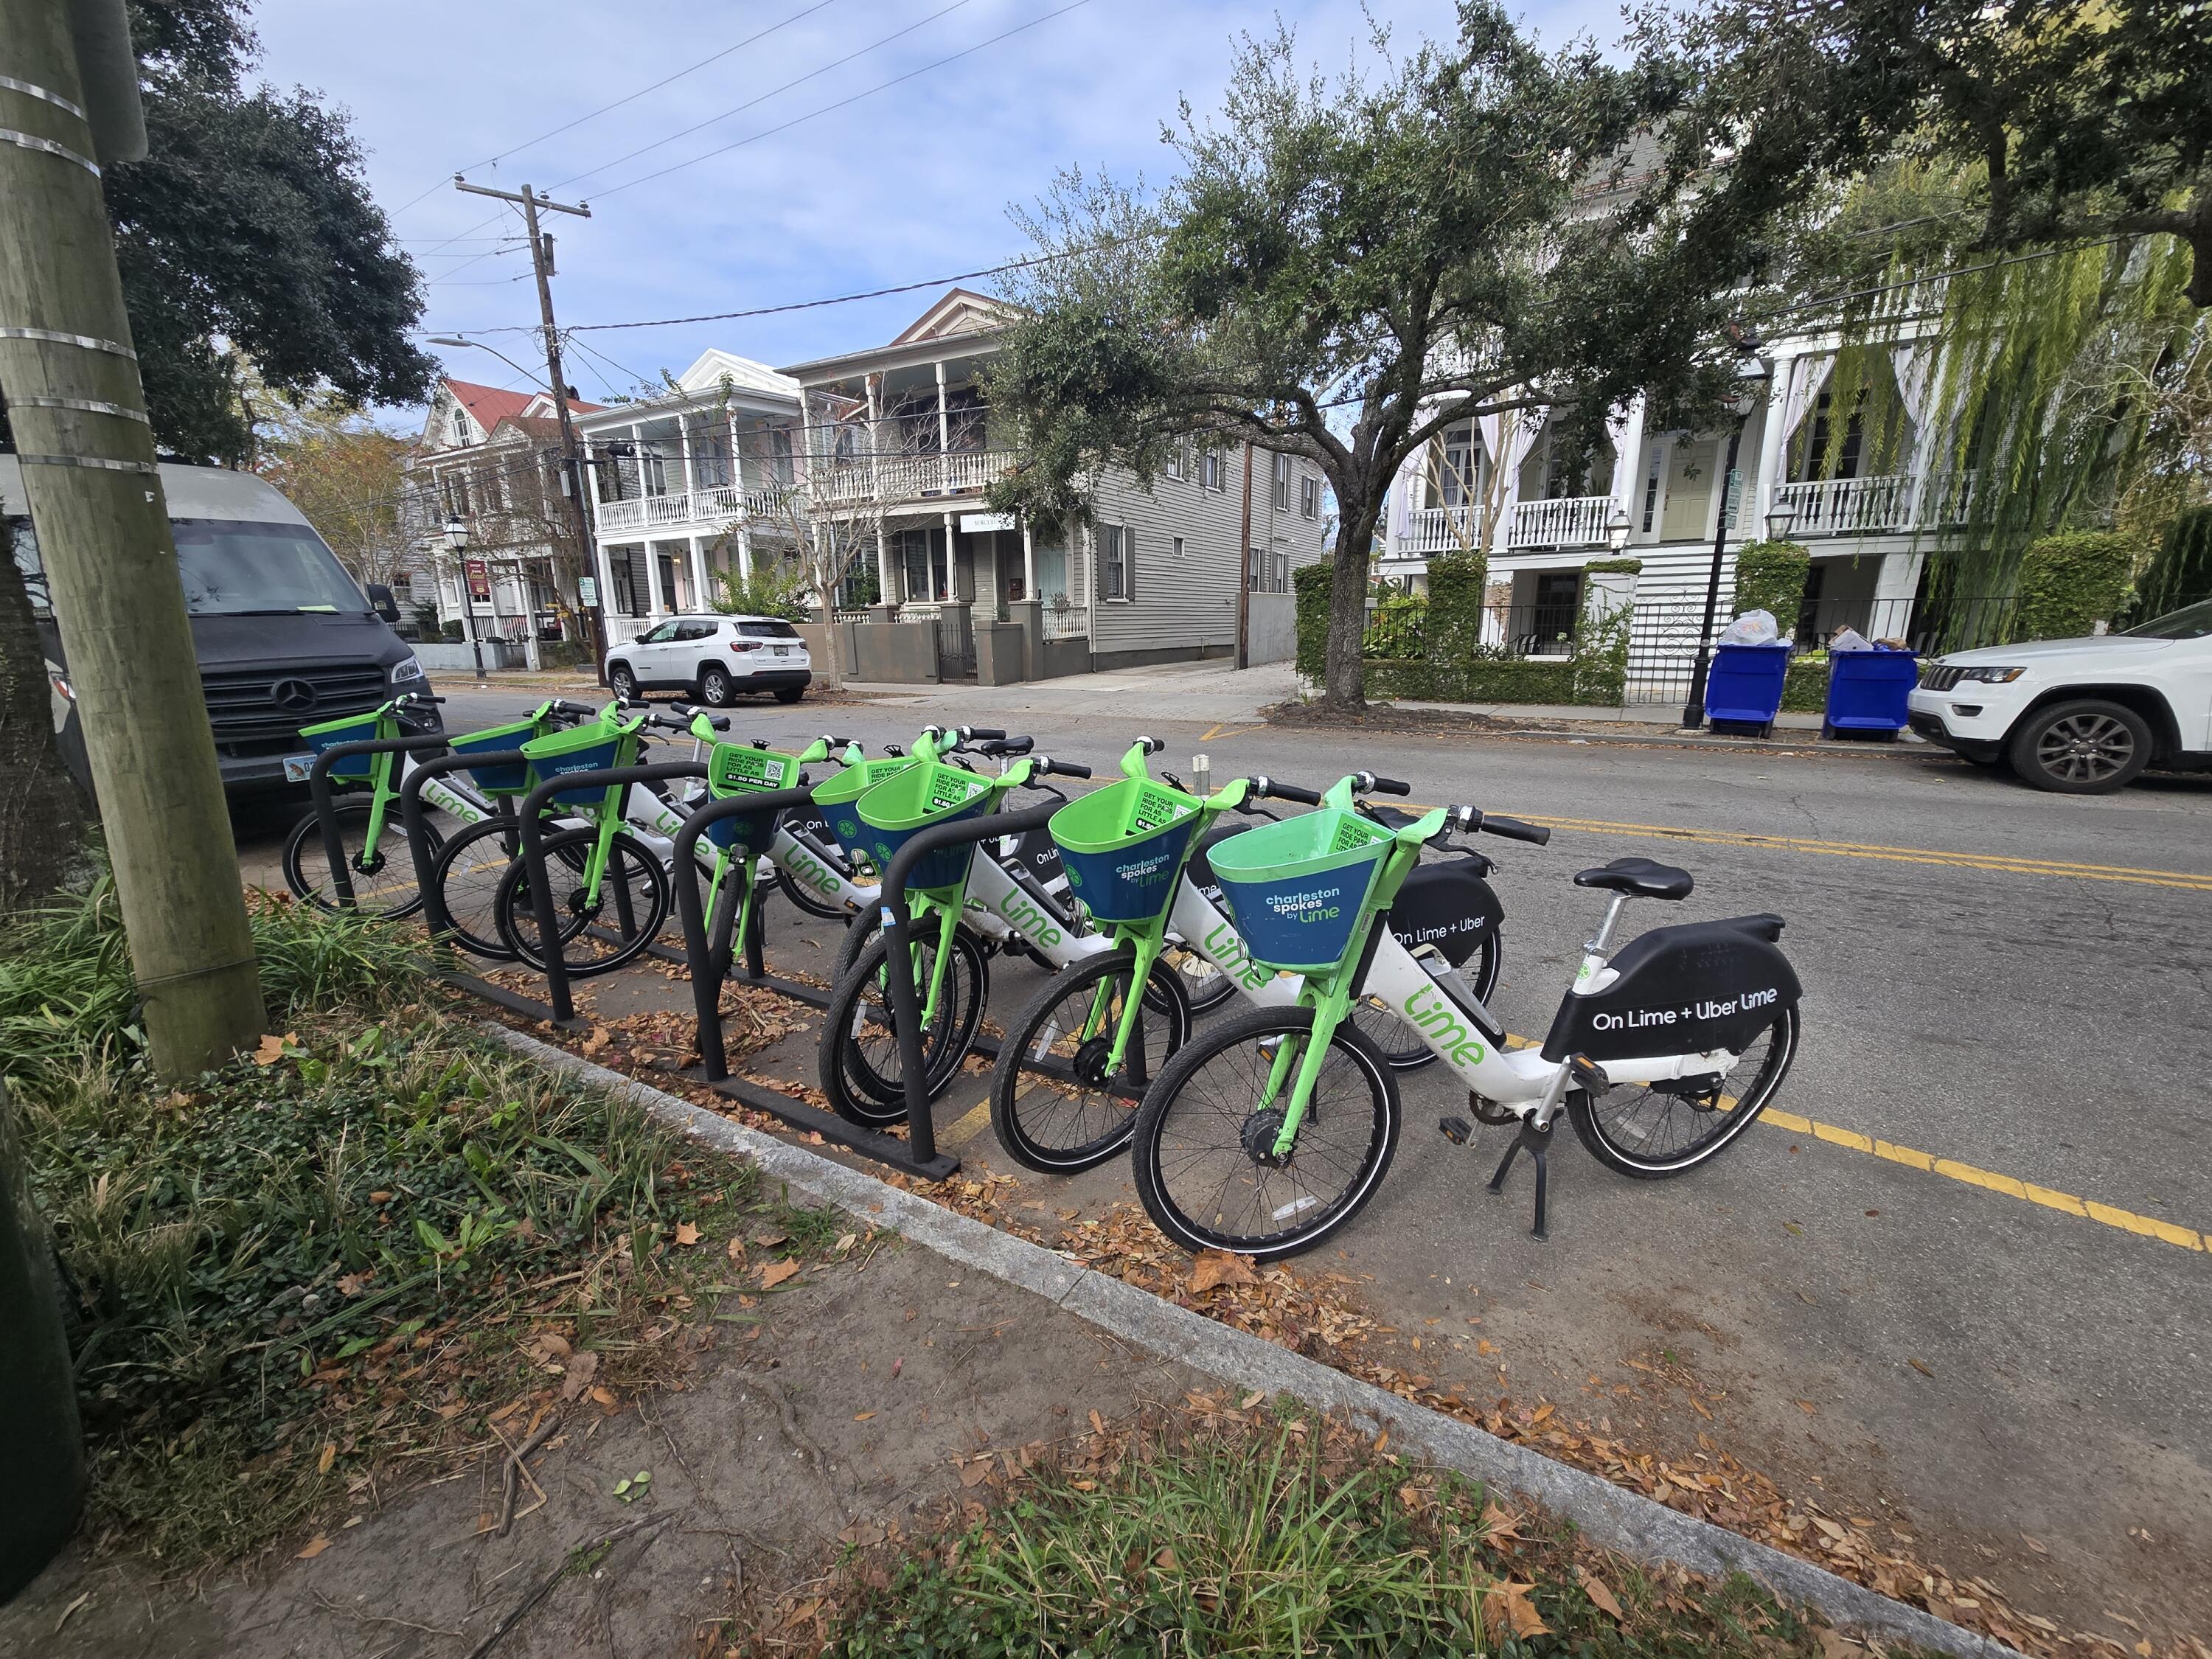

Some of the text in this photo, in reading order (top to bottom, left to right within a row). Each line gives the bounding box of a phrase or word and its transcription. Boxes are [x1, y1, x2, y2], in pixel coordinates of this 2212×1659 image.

[555, 762, 598, 773] charleston
[936, 779, 950, 787] RIDE
[950, 776, 966, 785] YOUR
[934, 789, 952, 799] LITTLE
[1144, 792, 1173, 807] GET YOUR
[426, 784, 479, 824] Lime
[1141, 804, 1152, 813] FOR
[1142, 798, 1156, 807] RIDE
[1138, 809, 1158, 821] LITTLE
[656, 810, 709, 857] Lie
[807, 821, 822, 830] On
[1343, 823, 1368, 840] GET YOUR
[1338, 837, 1349, 846] FOR
[1340, 830, 1353, 841] RIDE
[1336, 844, 1349, 852] LITT
[1037, 853, 1049, 864] On
[1116, 854, 1169, 874] charleston
[784, 843, 841, 895] Lime
[1121, 863, 1157, 880] spokes
[1139, 870, 1169, 888] Lime
[1266, 888, 1339, 905] charleston
[1274, 897, 1323, 914] spokes
[1001, 887, 1061, 949] Lime
[1300, 907, 1340, 923] Lime
[1393, 916, 1485, 945] On Lime + Uber
[1593, 988, 1778, 1031] On Lime + Uber Lime
[1404, 983, 1485, 1068] Lime
